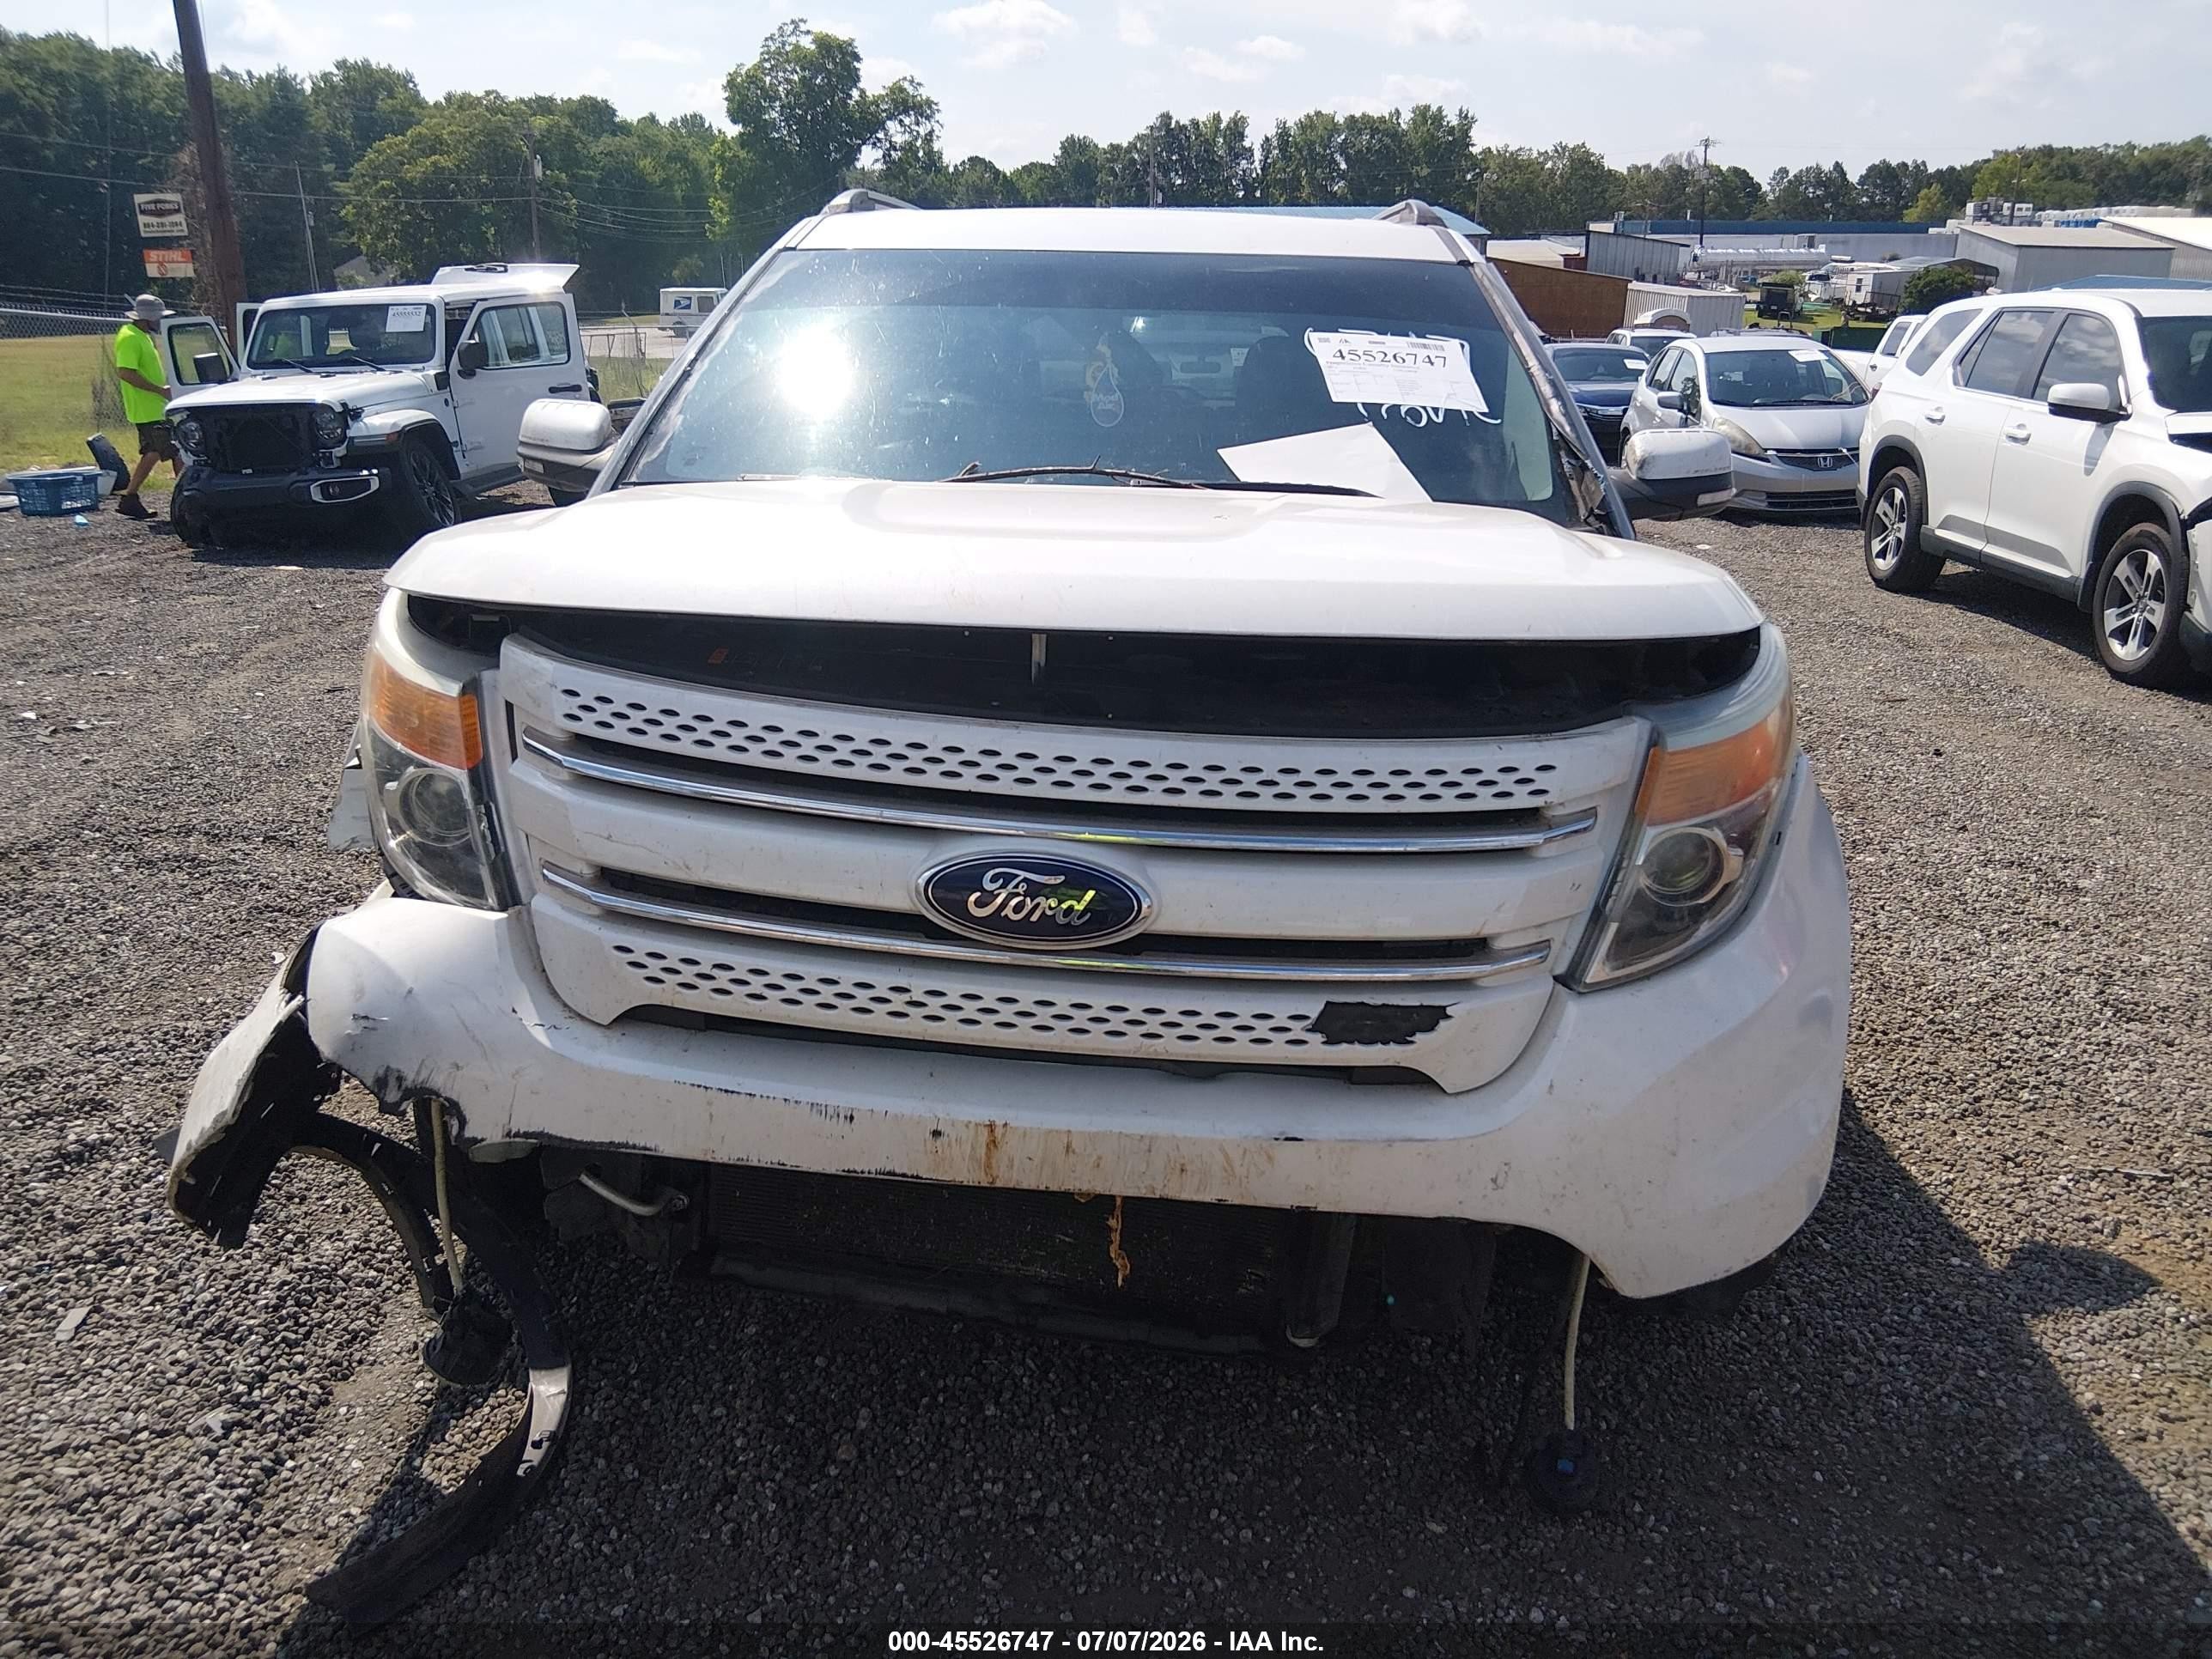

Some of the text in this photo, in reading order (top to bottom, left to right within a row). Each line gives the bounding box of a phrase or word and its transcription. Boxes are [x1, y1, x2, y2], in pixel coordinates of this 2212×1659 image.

[149, 249, 186, 262] STIHL
[1333, 348, 1448, 368] 45526747
[967, 867, 1097, 926] Ford
